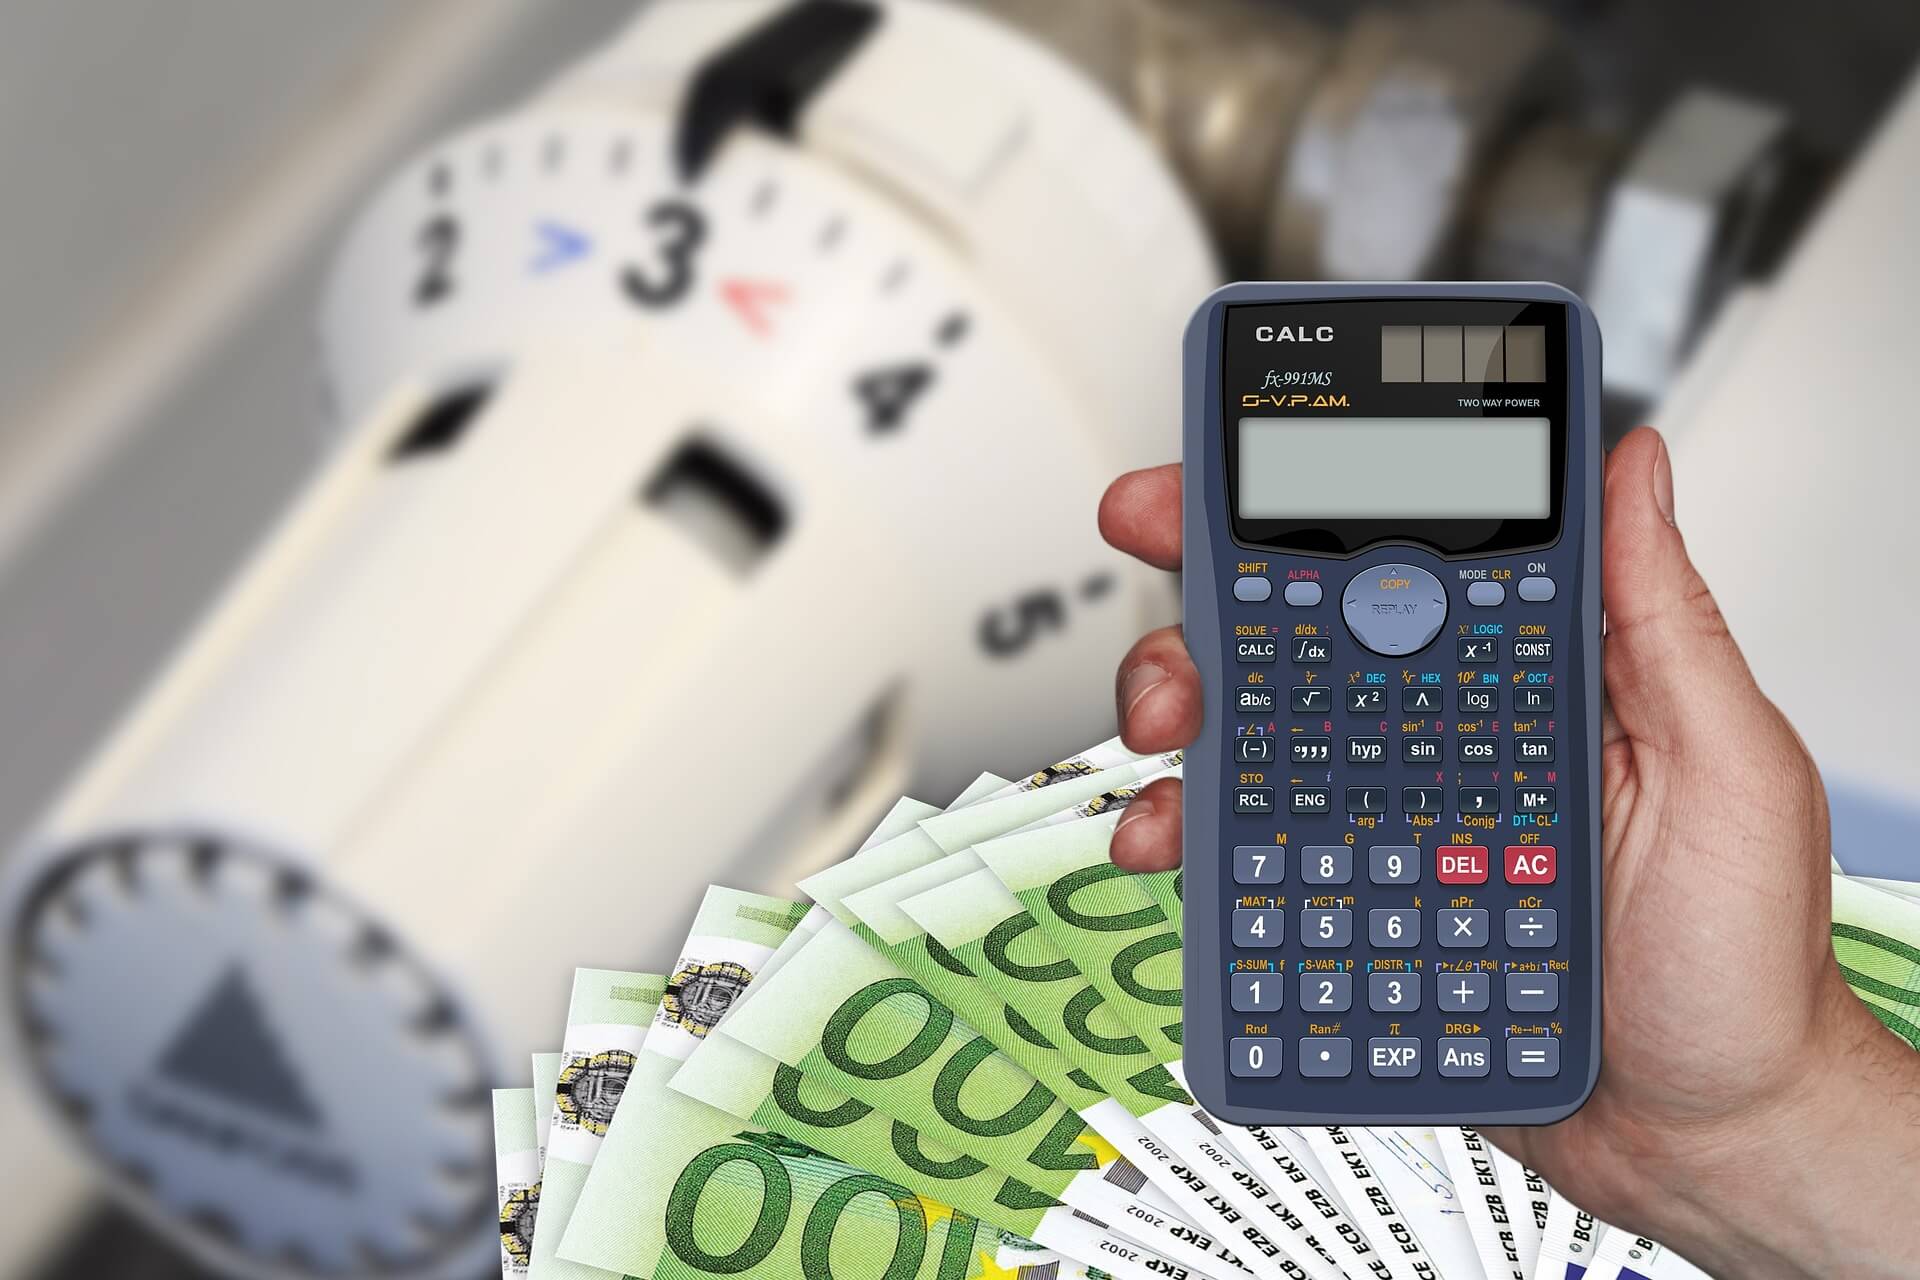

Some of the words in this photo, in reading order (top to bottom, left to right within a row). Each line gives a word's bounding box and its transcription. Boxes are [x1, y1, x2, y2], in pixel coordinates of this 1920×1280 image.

[620, 205, 708, 309] 3
[1255, 326, 1335, 343] CALC
[1260, 369, 1333, 389] fx-991MS
[852, 360, 937, 438] 4
[1458, 398, 1480, 407] TWO
[1482, 398, 1503, 407] WAY
[1505, 398, 1540, 407] POWER
[1238, 562, 1268, 573] SHIFT
[1527, 562, 1546, 573] ON
[1288, 570, 1320, 579] ALPHA
[1459, 569, 1487, 580] MODE
[1491, 569, 1511, 580] CLR
[1379, 578, 1411, 590] COPY
[1371, 604, 1417, 615] REPLAY
[976, 590, 1068, 659] 5
[1235, 625, 1267, 636] SOLVE
[1295, 624, 1318, 636] d/dx
[1474, 624, 1504, 635] LOGIC
[1519, 625, 1546, 636] CONV
[1238, 643, 1275, 656] CALC
[1515, 643, 1551, 656] CONST
[1248, 672, 1264, 683] d/c
[1366, 673, 1386, 683] DEC
[1421, 673, 1441, 683] HEX
[1483, 673, 1499, 683] BIN
[1527, 673, 1547, 683] OCT
[1467, 691, 1489, 709] log
[1267, 722, 1276, 732] A
[1324, 721, 1332, 732] B
[1380, 721, 1388, 732] C
[1436, 721, 1443, 732] D
[1492, 721, 1499, 732] E
[1549, 721, 1555, 732] F
[1351, 742, 1382, 759] hyp
[1410, 742, 1435, 756] sin
[1464, 744, 1494, 756] cos
[1522, 742, 1548, 756] tan
[1240, 773, 1264, 784] STO
[1492, 772, 1500, 782] Y
[1548, 772, 1556, 782] M
[1239, 793, 1269, 806] RCL
[1295, 793, 1326, 806] ENG
[1523, 793, 1547, 807] M+
[1357, 816, 1375, 829] arg
[1412, 815, 1433, 826] Abs
[1464, 815, 1495, 829] Conjg
[1513, 815, 1528, 826] DT
[1536, 815, 1551, 826] CL
[1276, 833, 1287, 844] M
[1344, 833, 1355, 844] G
[1413, 833, 1422, 844] T
[1451, 833, 1473, 844] INS
[1519, 833, 1540, 844] OFF
[1251, 855, 1267, 878] 7
[1319, 855, 1334, 878] 8
[1387, 855, 1402, 878] 9
[1442, 856, 1483, 874] DEL
[1513, 855, 1548, 875] AC
[1242, 896, 1267, 906] MAT
[1312, 896, 1335, 906] VCT
[1343, 896, 1354, 905] m
[1414, 896, 1422, 907] k
[1451, 896, 1474, 907] nPr
[1519, 896, 1543, 907] nCr
[1250, 915, 1266, 939] 4
[1319, 915, 1334, 939] 5
[1387, 915, 1402, 939] 6
[1236, 959, 1268, 970] S-SUM
[1305, 959, 1335, 970] S-VAR
[1374, 960, 1403, 970] DISTR
[1249, 981, 1261, 1004] 1
[1318, 981, 1334, 1004] 2
[1387, 981, 1402, 1005] 3
[1245, 1023, 1268, 1034] Rnd
[1309, 1022, 1342, 1034] Ran#
[1445, 1023, 1472, 1034] DRG
[1550, 1022, 1563, 1034] %
[1249, 1045, 1264, 1069] 0
[1373, 1047, 1416, 1067] EXP
[1443, 1047, 1485, 1067] Ans
[1325, 1125, 1350, 1146] EK
[1137, 1135, 1170, 1162] 2002
[1198, 1142, 1232, 1168] 2002
[1272, 1155, 1308, 1184] EKT
[1340, 1150, 1372, 1179] EKT
[1471, 1156, 1497, 1186] EKT
[1169, 1164, 1208, 1193] EKP
[1231, 1170, 1269, 1200] EKP
[1304, 1188, 1340, 1219] EZB
[1365, 1186, 1396, 1217] EZB
[1203, 1195, 1243, 1224] EKT
[1265, 1201, 1304, 1231] EKT
[1485, 1194, 1511, 1225] EZB
[1126, 1204, 1165, 1229] 2002
[1573, 1211, 1595, 1242] BCE
[1169, 1226, 1213, 1252] EKP
[1243, 1226, 1281, 1258] EZB
[1335, 1223, 1371, 1255] ECB
[1387, 1222, 1420, 1254] ECB
[1099, 1240, 1139, 1262] 2002
[1144, 1258, 1189, 1280] EKP
[1280, 1259, 1313, 1280] CB
[1367, 1259, 1394, 1280] CE
[1411, 1260, 1437, 1280] CE
